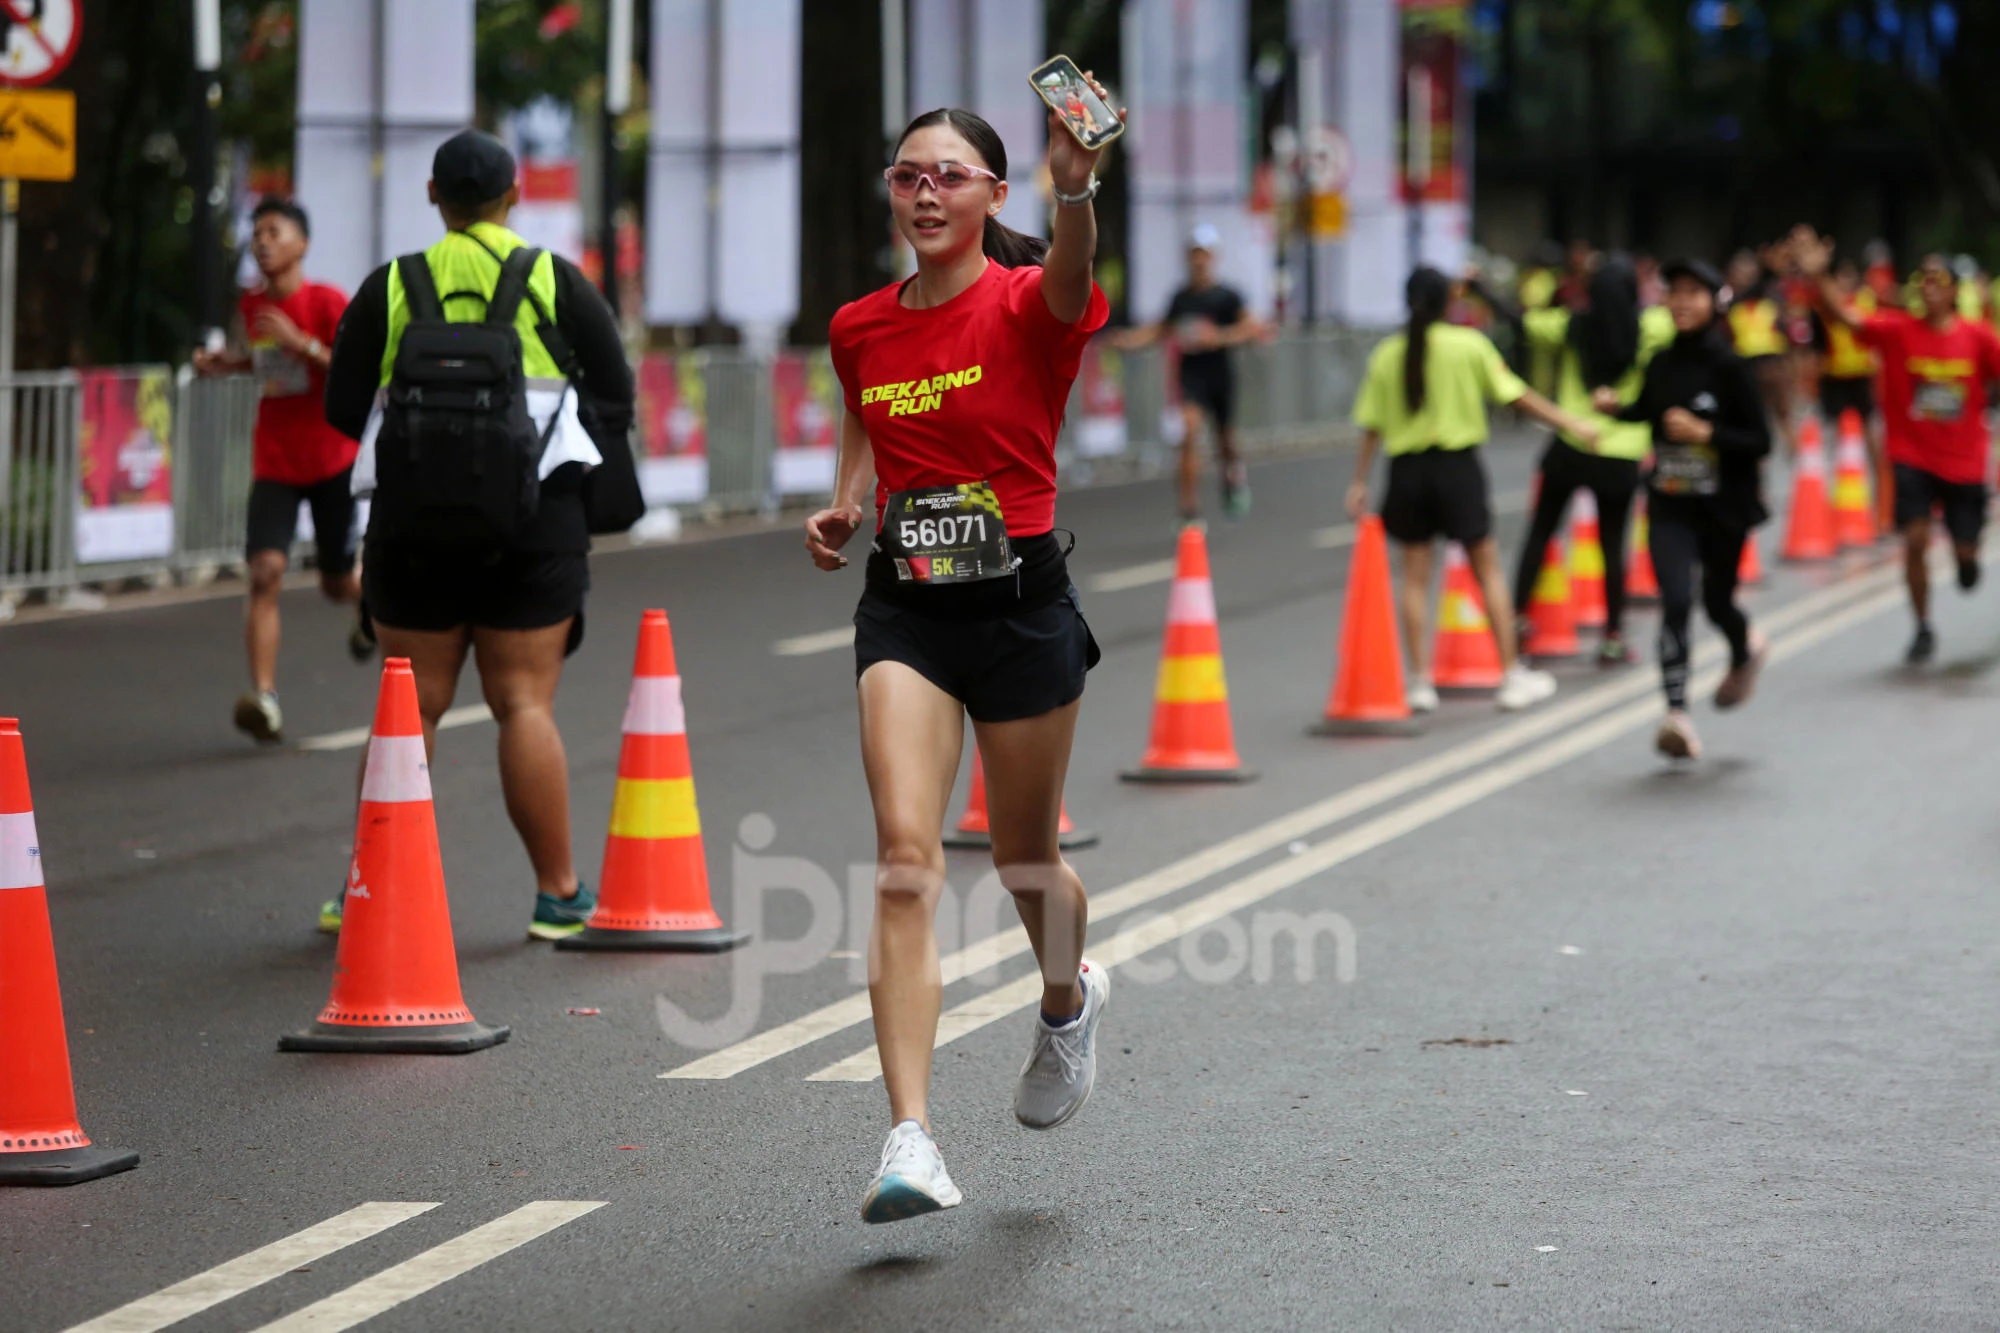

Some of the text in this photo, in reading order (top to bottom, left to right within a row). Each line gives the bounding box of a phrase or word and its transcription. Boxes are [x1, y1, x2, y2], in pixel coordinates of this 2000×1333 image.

[861, 365, 981, 406] SOEKARNO
[889, 393, 942, 416] RUN
[900, 514, 987, 548] 56071
[932, 557, 954, 576] 5K
